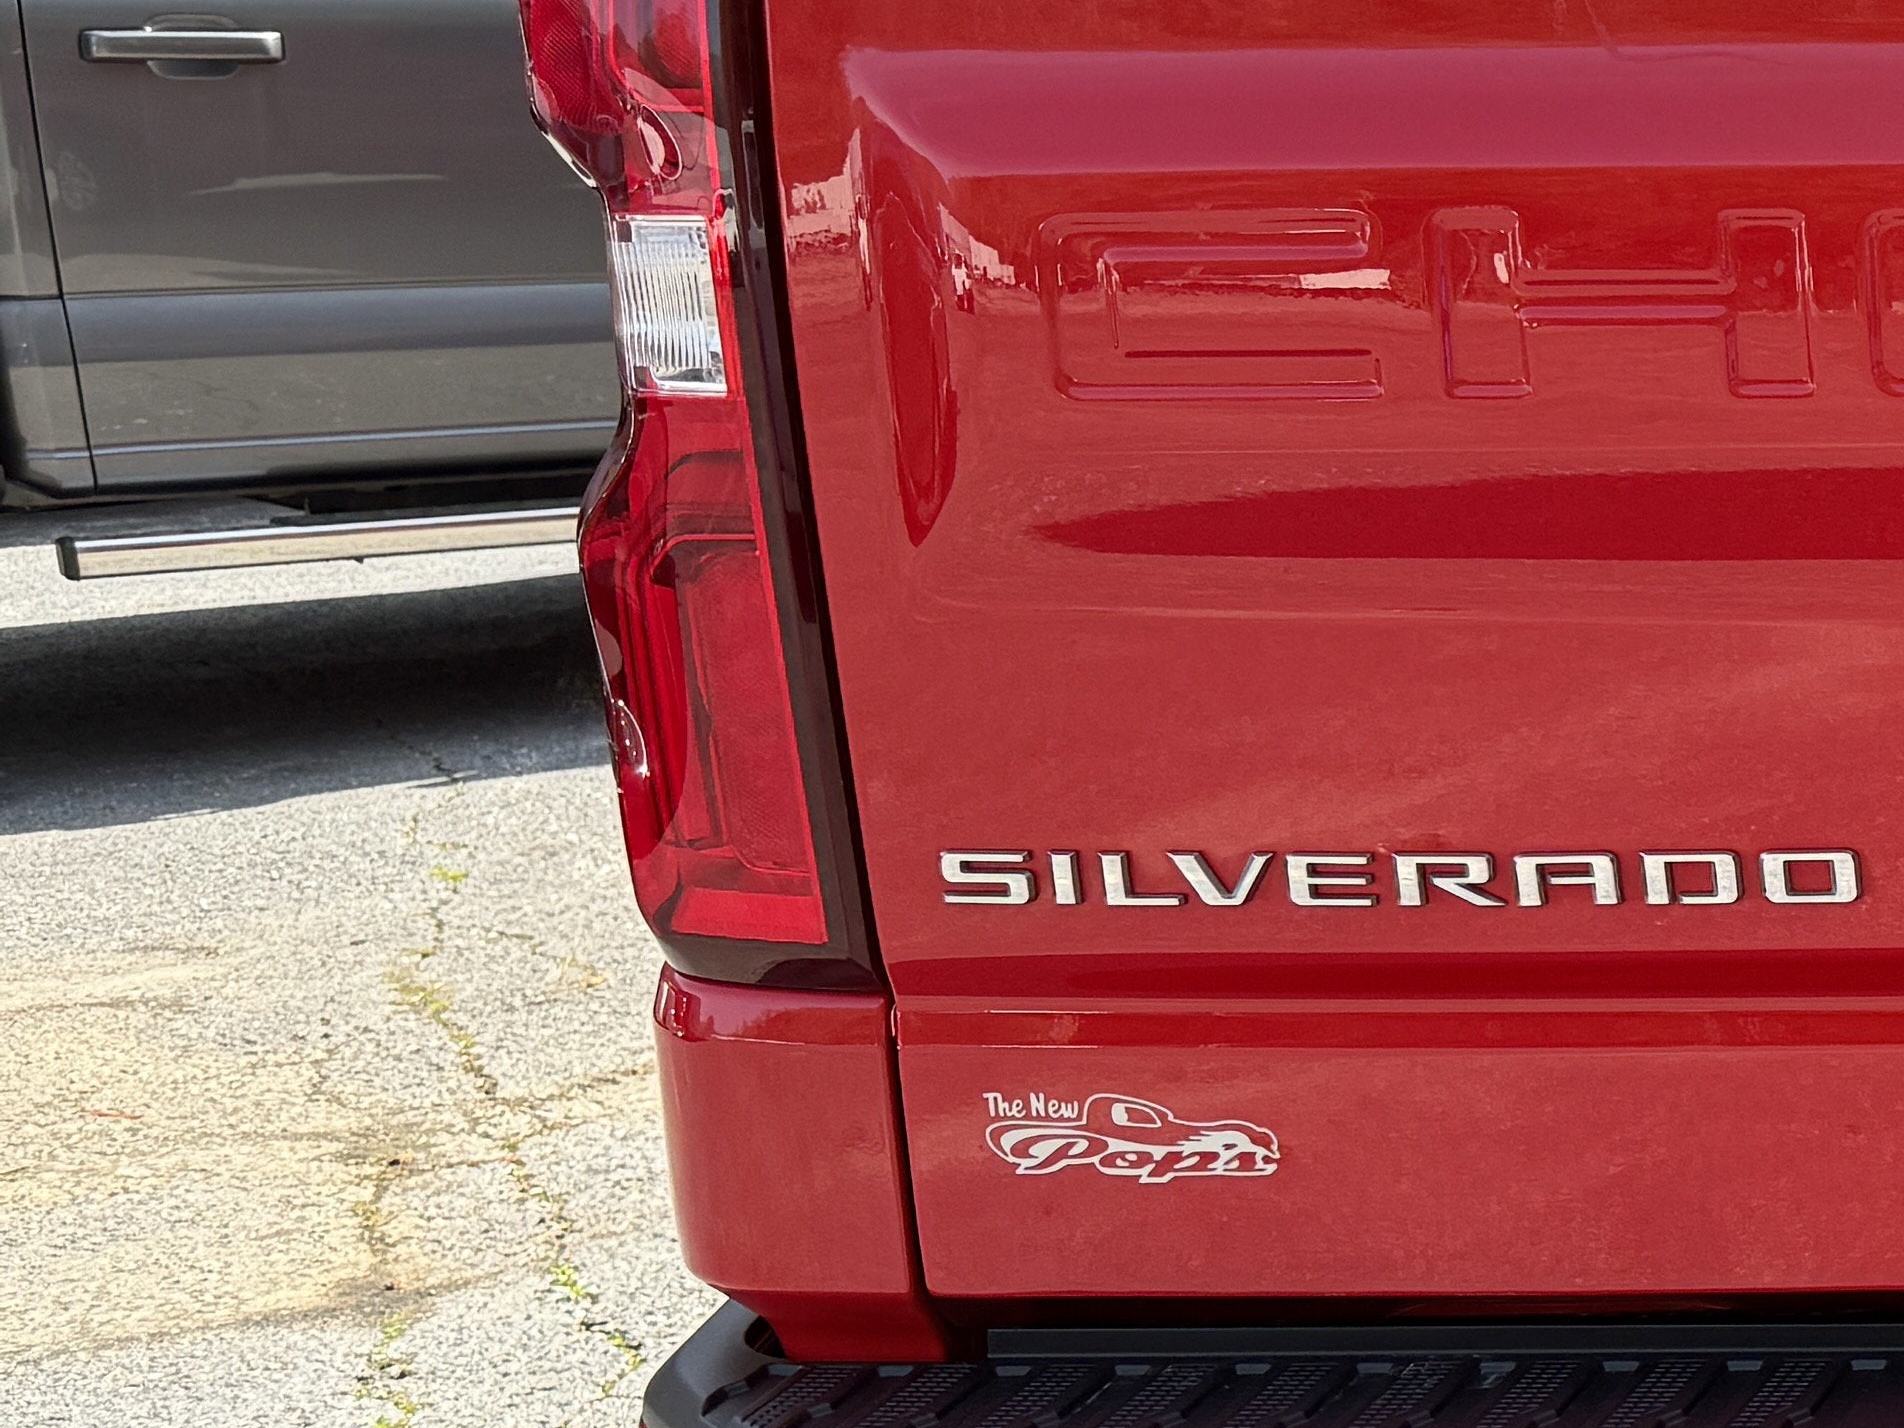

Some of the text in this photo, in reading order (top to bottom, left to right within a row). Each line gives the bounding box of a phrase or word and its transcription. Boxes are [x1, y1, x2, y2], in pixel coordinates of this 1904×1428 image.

[940, 850, 1861, 908] SILVERADO
[983, 1092, 1079, 1118] The New
